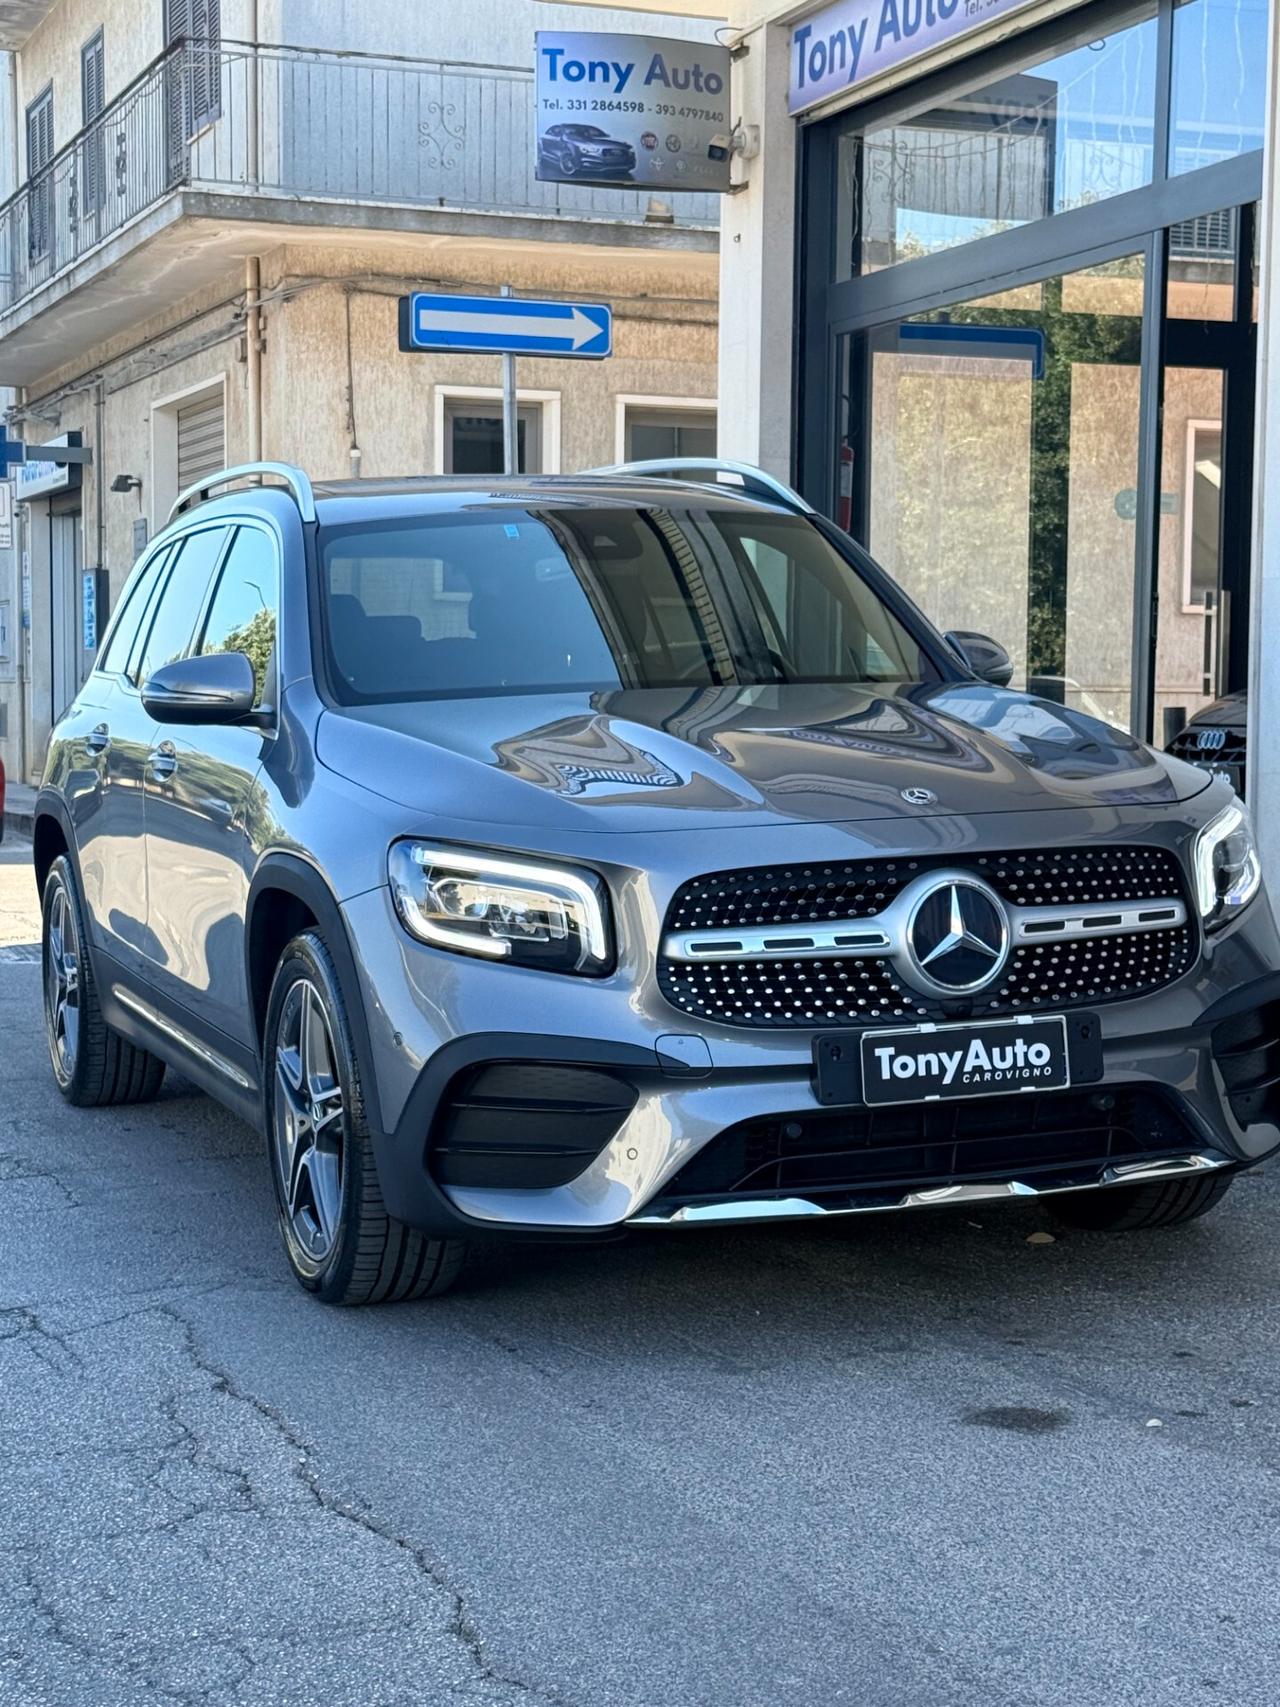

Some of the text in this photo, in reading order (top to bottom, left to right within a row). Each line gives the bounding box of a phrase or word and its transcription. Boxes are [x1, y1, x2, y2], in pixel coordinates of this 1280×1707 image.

[794, 18, 868, 89] Tony
[542, 48, 724, 95] Tony Auto
[542, 99, 564, 111] Tel.
[567, 100, 588, 111] 331
[592, 100, 645, 113] 2864598
[655, 104, 677, 116] 393
[678, 107, 724, 122] 4797840
[963, 1067, 1052, 1083] CAROVIGNO
